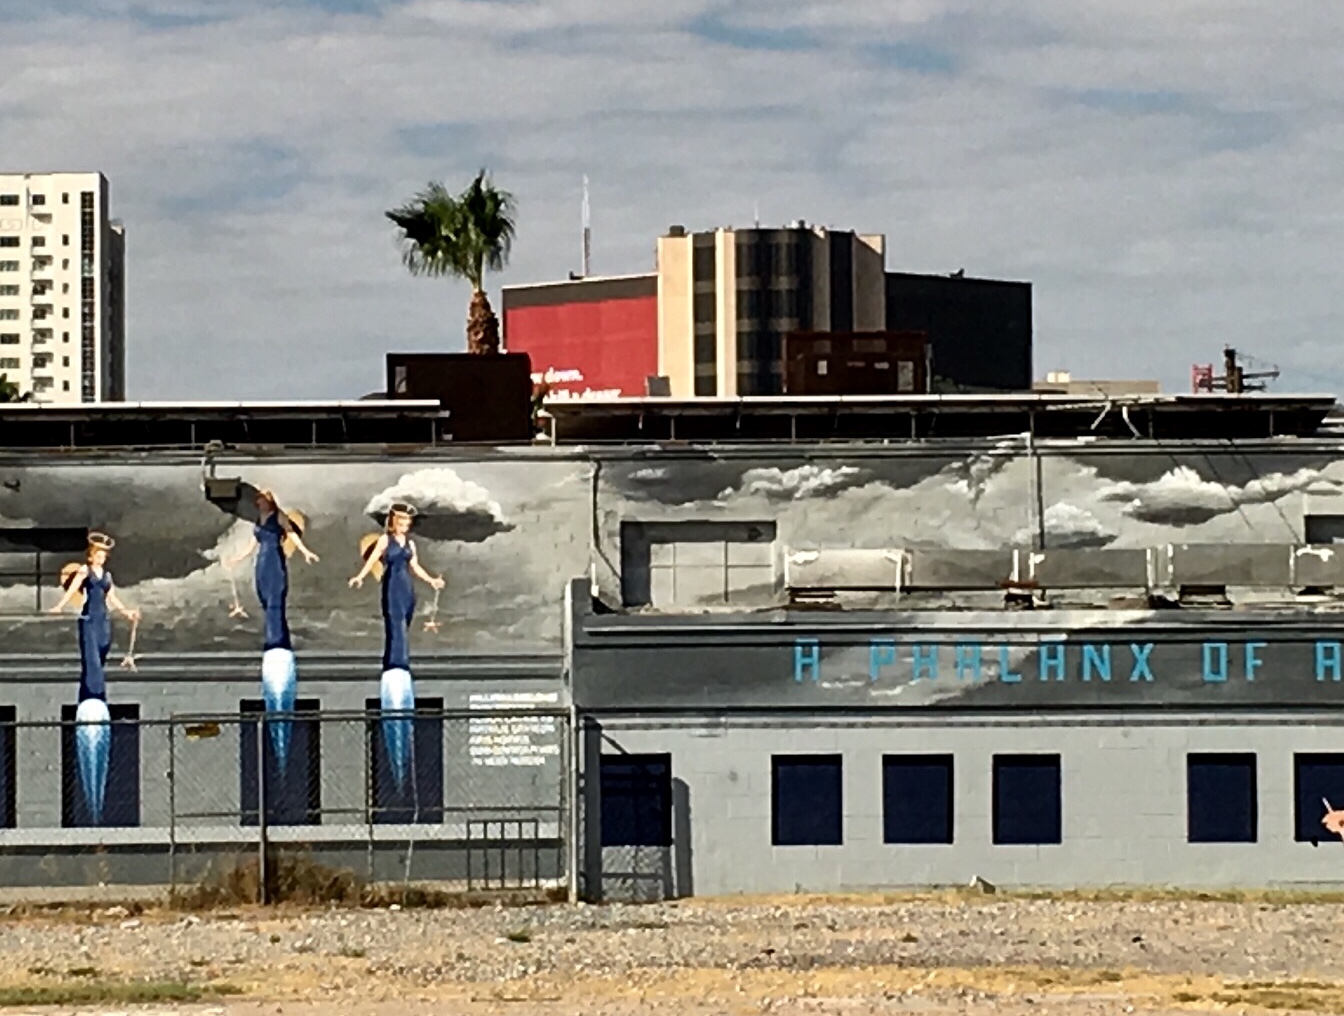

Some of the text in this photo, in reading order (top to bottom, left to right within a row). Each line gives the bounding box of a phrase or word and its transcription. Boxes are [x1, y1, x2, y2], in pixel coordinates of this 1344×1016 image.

[794, 639, 821, 682] A
[869, 639, 1155, 683] PHALANX
[1202, 642, 1268, 682] OF
